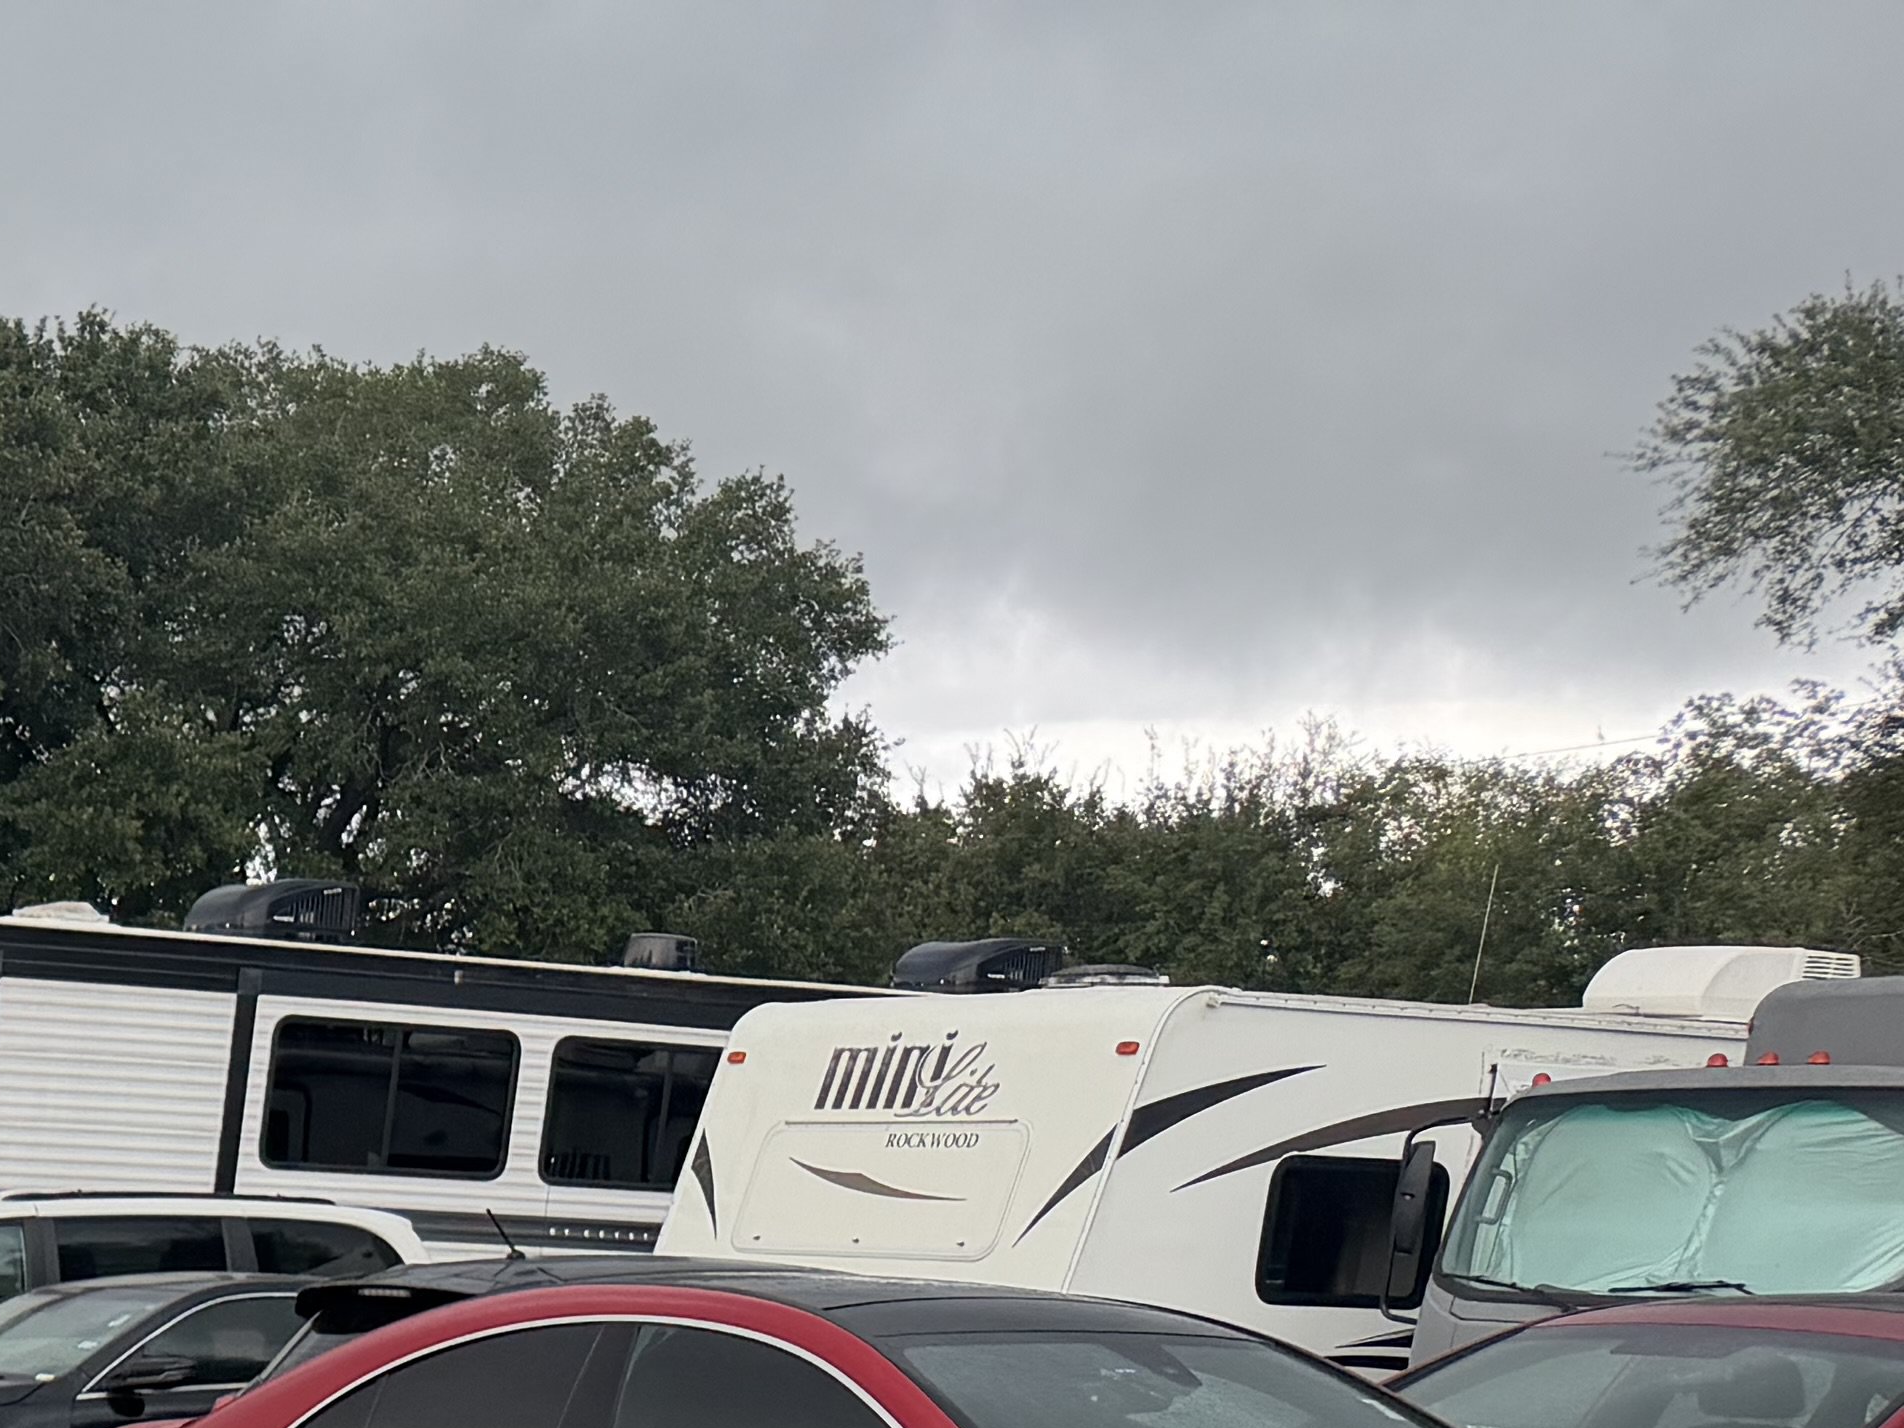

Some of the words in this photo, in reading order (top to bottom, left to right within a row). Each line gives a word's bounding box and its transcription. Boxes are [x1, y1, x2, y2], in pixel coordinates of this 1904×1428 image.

[814, 1030, 959, 1110] mini
[894, 1041, 1001, 1118] Lite
[885, 1132, 980, 1149] ROCKWOOD
